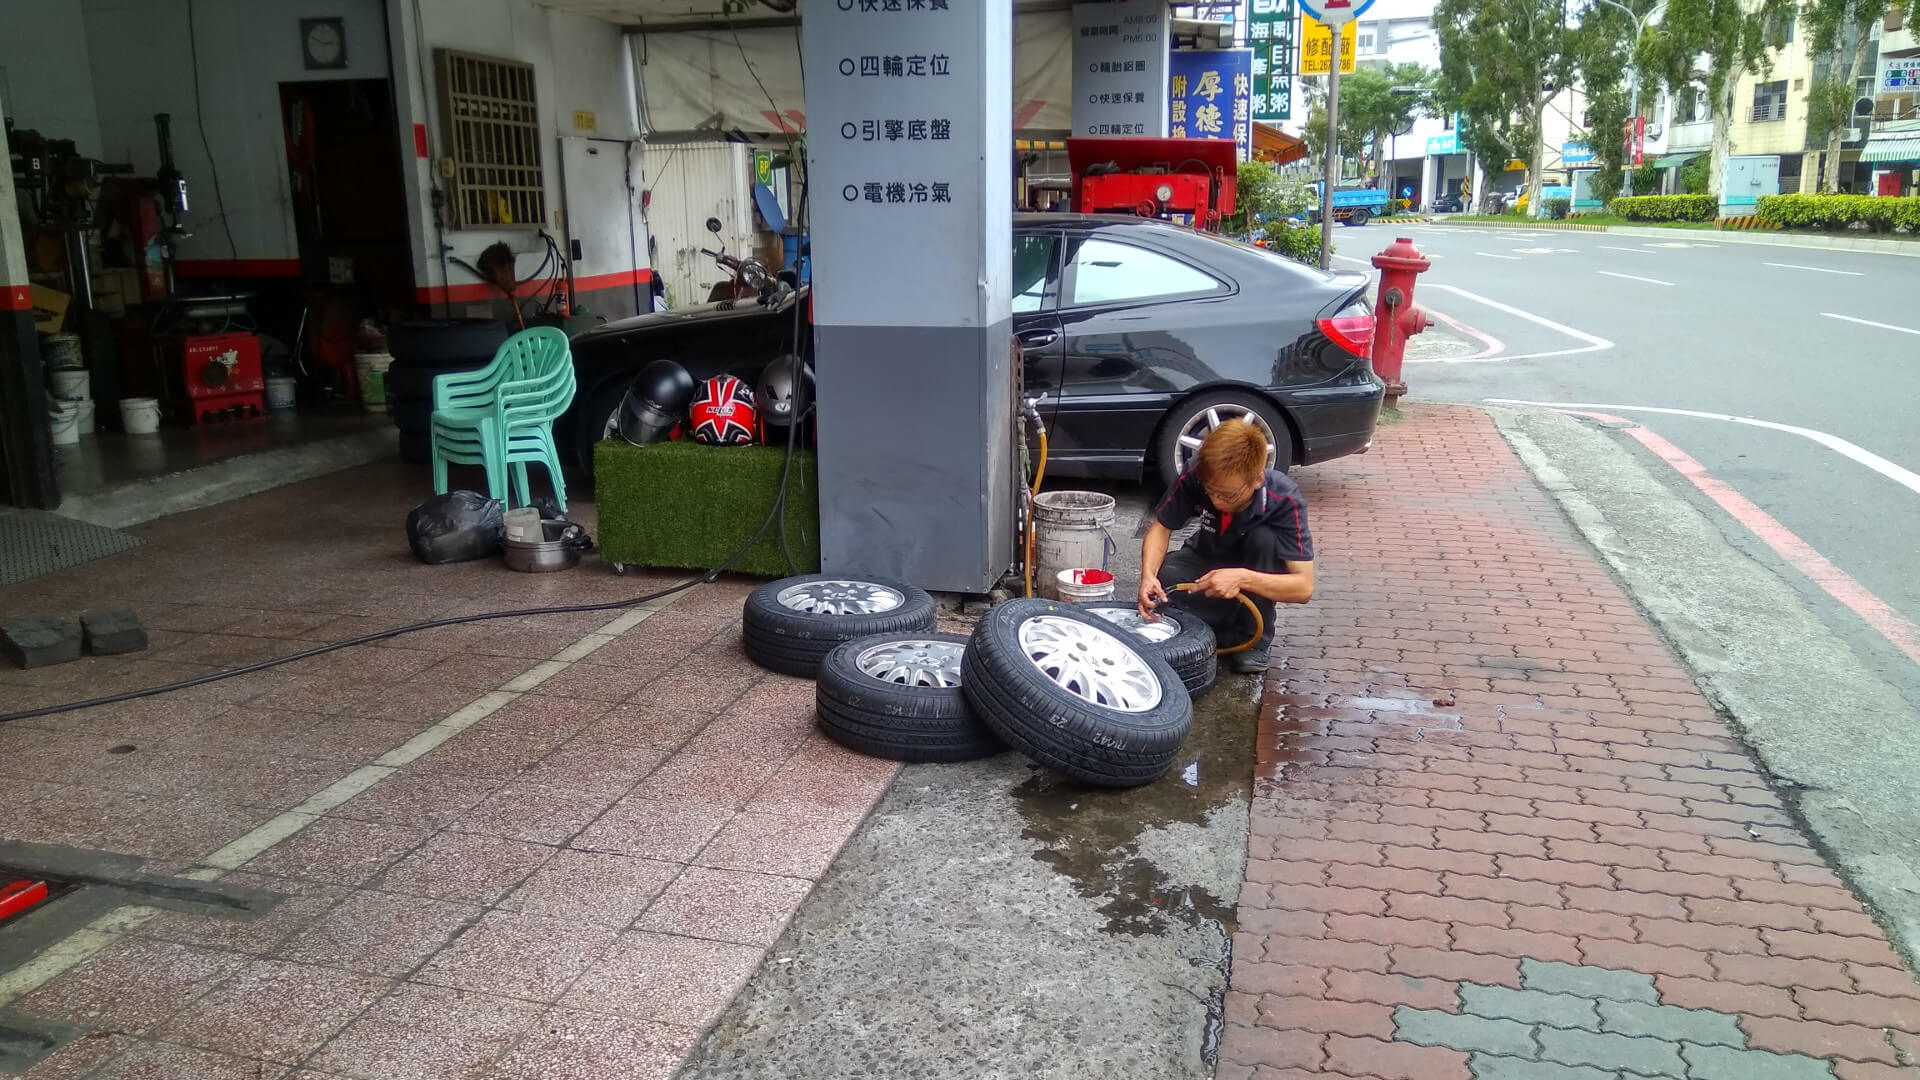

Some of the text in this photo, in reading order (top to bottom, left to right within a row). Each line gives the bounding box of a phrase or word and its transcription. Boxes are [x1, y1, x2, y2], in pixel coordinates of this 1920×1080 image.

[860, 54, 950, 77] 四輪定位
[1100, 93, 1145, 104] 快速保養
[1192, 71, 1224, 139] 厚德
[862, 119, 951, 141] 引擎底盤
[1099, 123, 1145, 135] 四輪定位
[760, 160, 769, 174] BP
[863, 182, 951, 204] 電機冷氣
